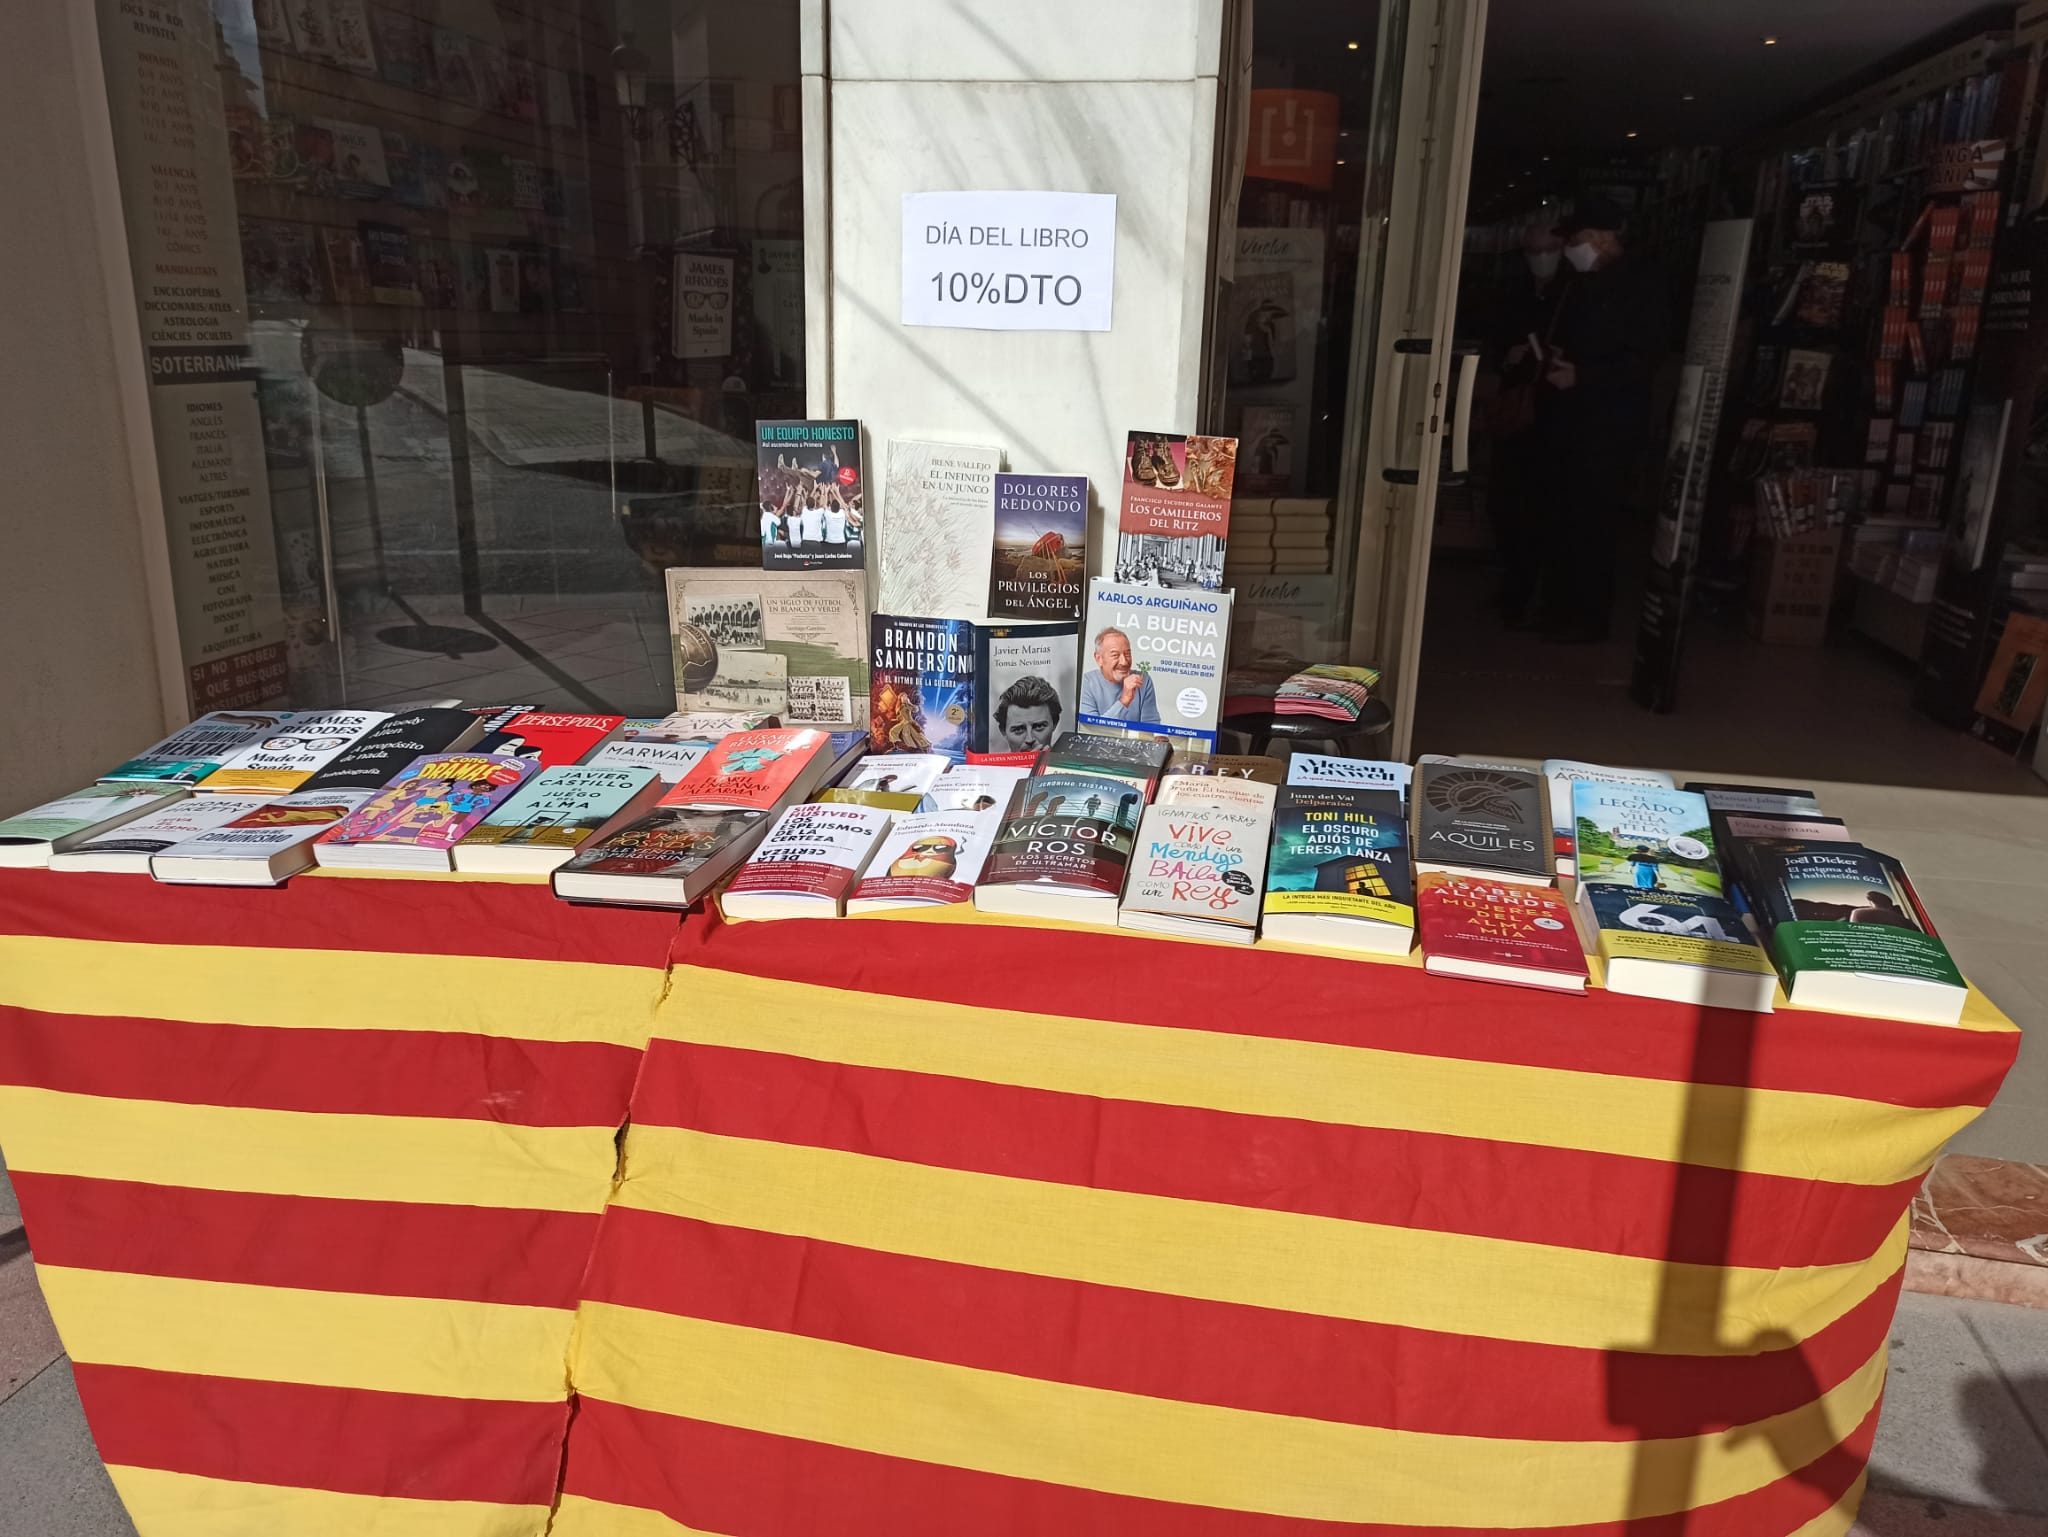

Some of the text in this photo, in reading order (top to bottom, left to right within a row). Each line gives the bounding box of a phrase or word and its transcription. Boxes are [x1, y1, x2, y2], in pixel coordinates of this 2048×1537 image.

[133, 20, 176, 40] REVISTES
[137, 51, 178, 70] INFANTIL
[926, 221, 1089, 249] DÍA DEL LIBRO
[155, 263, 218, 277] MANUALITATS
[689, 262, 725, 275] JAMES
[685, 275, 729, 289] RHODES
[931, 271, 1082, 306] 10%DTO
[163, 316, 219, 327] ASTROLOGIA
[688, 313, 724, 325] Made in
[196, 331, 233, 341] OCULTES
[692, 326, 719, 338] Spain
[152, 355, 241, 374] SOTERRANI
[186, 402, 224, 413] IDIOMES
[761, 427, 855, 441] UN EQUIPO HONESTO
[931, 459, 991, 471] IRENE VALLEJO
[930, 470, 990, 484] EL INFINITO
[922, 481, 989, 495] EN UN JUNCO
[1003, 483, 1078, 498] DOLORES
[199, 503, 236, 517] ESPORTS
[1001, 498, 1081, 512] REDONDO
[1130, 503, 1222, 521] LOS CAMILLEROS
[1150, 518, 1199, 532] DEL RITZ
[192, 542, 250, 560] AGRICULTURA
[206, 555, 241, 571] NATURA
[1029, 571, 1047, 580] LOS
[216, 583, 237, 596] CINE
[998, 580, 1080, 594] PRIVILEGIOS
[1005, 594, 1071, 609] DEL ÁNGEL
[1098, 591, 1218, 613] KARLOS ARGUIÑANO
[1116, 612, 1218, 638] LA BUENA
[202, 632, 262, 656] ARQUITECTURA
[885, 629, 958, 651] BRANDON
[1137, 635, 1217, 659] COCINA
[994, 644, 1051, 656] Javier Marías
[212, 648, 277, 675] NO TROBEU
[875, 649, 967, 674] SANDERSON
[994, 658, 1051, 667] Tomás Nevinson
[1173, 660, 1215, 671] RECETAS QUE
[1153, 666, 1215, 678] SIEMPRE SALEN BIEN
[206, 663, 287, 697] QUE BUSQUEU
[885, 675, 893, 683] EL
[894, 676, 914, 685] RITMO
[915, 678, 923, 686] DE
[934, 679, 957, 688] GUERRA
[298, 716, 367, 725] JAMES
[1107, 719, 1128, 728] VENTAS
[194, 731, 257, 743] DOMINIO
[278, 726, 362, 735] RHODES
[1175, 728, 1198, 737] EDICIÓN
[150, 742, 236, 756] MENTAL
[361, 740, 425, 753] propósito
[247, 753, 316, 763] Made in
[418, 763, 504, 781] DRAMAS
[1299, 765, 1395, 781] Maxwell
[1307, 759, 1385, 774] Megan
[559, 772, 630, 781] JAVIER
[539, 780, 633, 789] CASTILLO
[1295, 798, 1353, 807] Delparaíso
[1318, 792, 1334, 800] del
[526, 801, 589, 809] ALMA
[1600, 797, 1685, 815] LEGADO
[785, 817, 813, 825] LOS
[789, 811, 868, 820] HUSTVEDT
[1158, 808, 1210, 821] IGNATIUS
[1304, 812, 1377, 825] TONI HILL
[1620, 812, 1667, 824] VILLA
[780, 822, 873, 836] ESPEJISMOS
[1010, 822, 1118, 846] VÍCTOR
[1302, 825, 1379, 838] EL OSCURO
[1619, 823, 1669, 834] TELAS
[1763, 823, 1821, 834] Quintana
[197, 833, 293, 843] COMUNISMO
[607, 837, 716, 850] POSADAS
[1307, 833, 1373, 847] ADIÓS DE
[1429, 831, 1535, 852] AQUILES
[1026, 841, 1086, 855] ROS
[1289, 845, 1392, 864] TERESA LANZA
[1043, 855, 1096, 866] SECRETOS
[1150, 842, 1243, 872] Mendigo
[1784, 856, 1857, 866] Joël Dicker
[1032, 860, 1087, 870] ULTRAMAR
[1802, 867, 1843, 876] enigma
[1803, 873, 1860, 882] habitación
[1862, 875, 1884, 885] 622
[1172, 881, 1239, 910] Rey
[1448, 880, 1539, 899] ISABEL
[1332, 895, 1369, 905] INQUIETANTE
[1434, 887, 1557, 909] ALLENDE
[1442, 897, 1553, 917] MUJERES
[1477, 911, 1522, 922] DEL
[1619, 903, 1741, 943] 64
[1468, 917, 1535, 932] ALMA
[1480, 926, 1526, 938] MÍA
